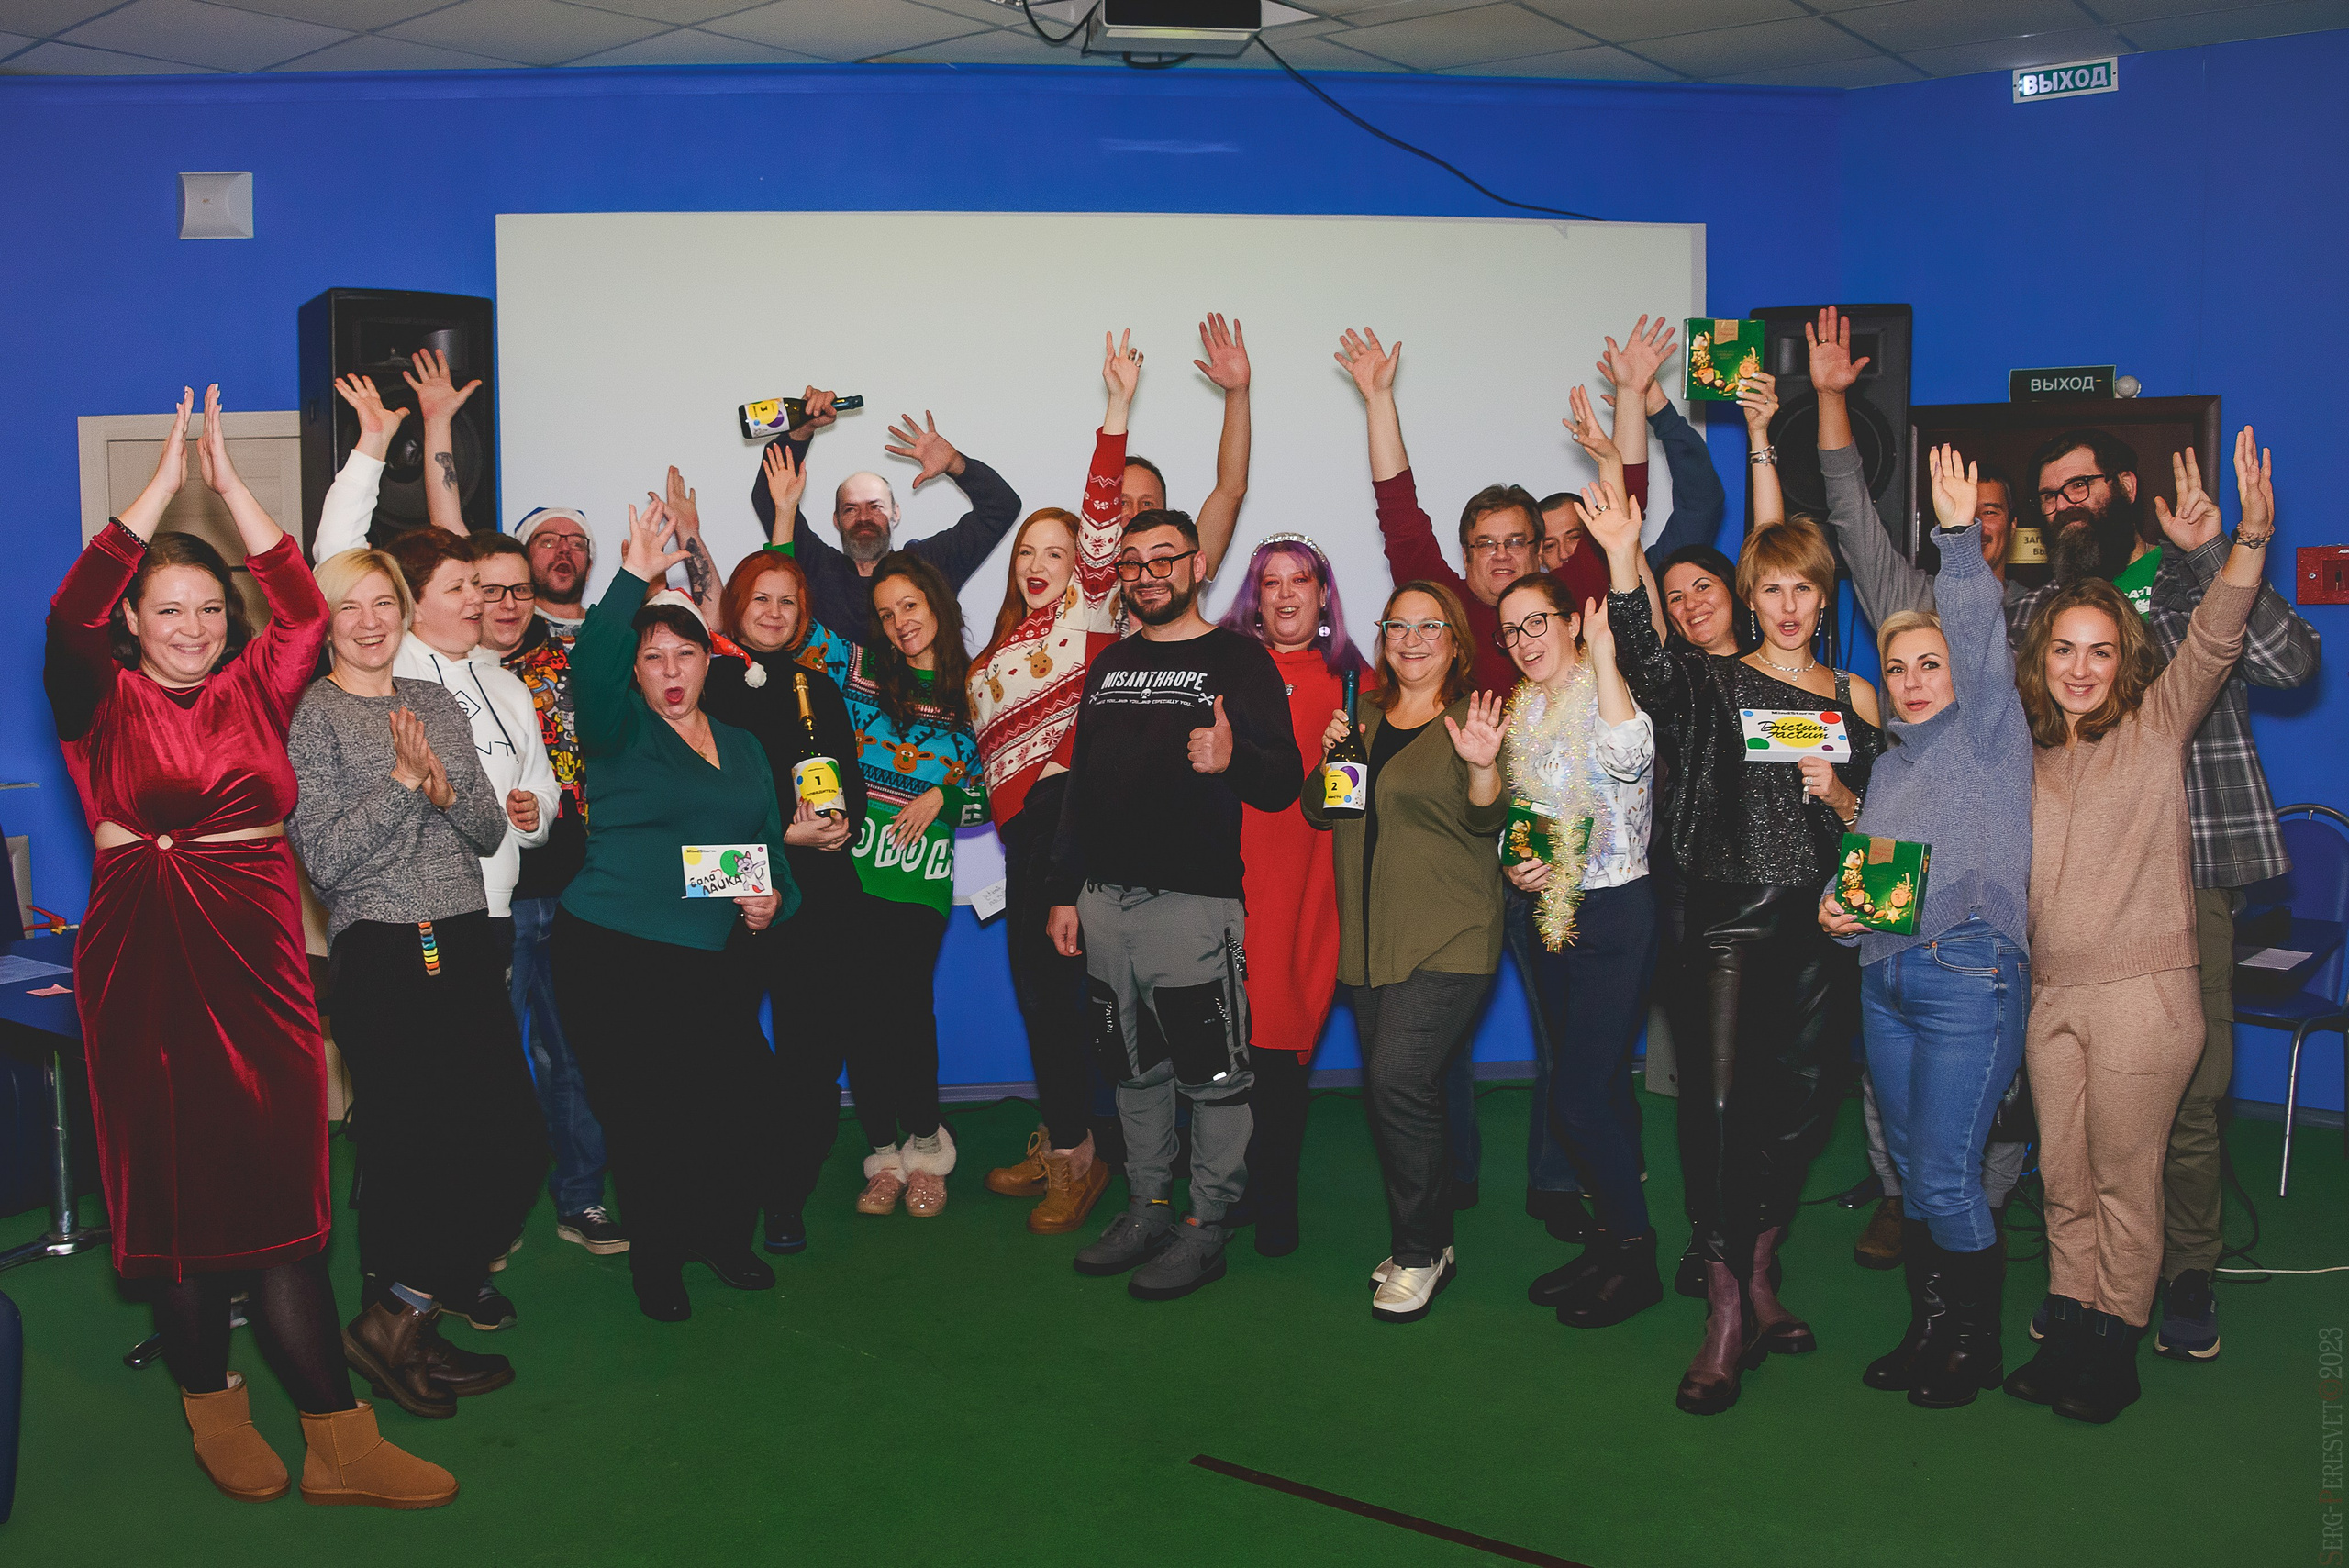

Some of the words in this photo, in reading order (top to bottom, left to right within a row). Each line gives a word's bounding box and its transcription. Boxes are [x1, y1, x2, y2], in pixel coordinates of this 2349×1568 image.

[2023, 66, 2108, 96] ВЫХОД
[2031, 376, 2095, 393] ВЫХОД
[1101, 671, 1208, 691] MISANTHROPE
[1757, 720, 1830, 732] Dictum
[1766, 728, 1830, 740] Factum
[815, 776, 821, 786] 1
[1331, 782, 1337, 791] 2
